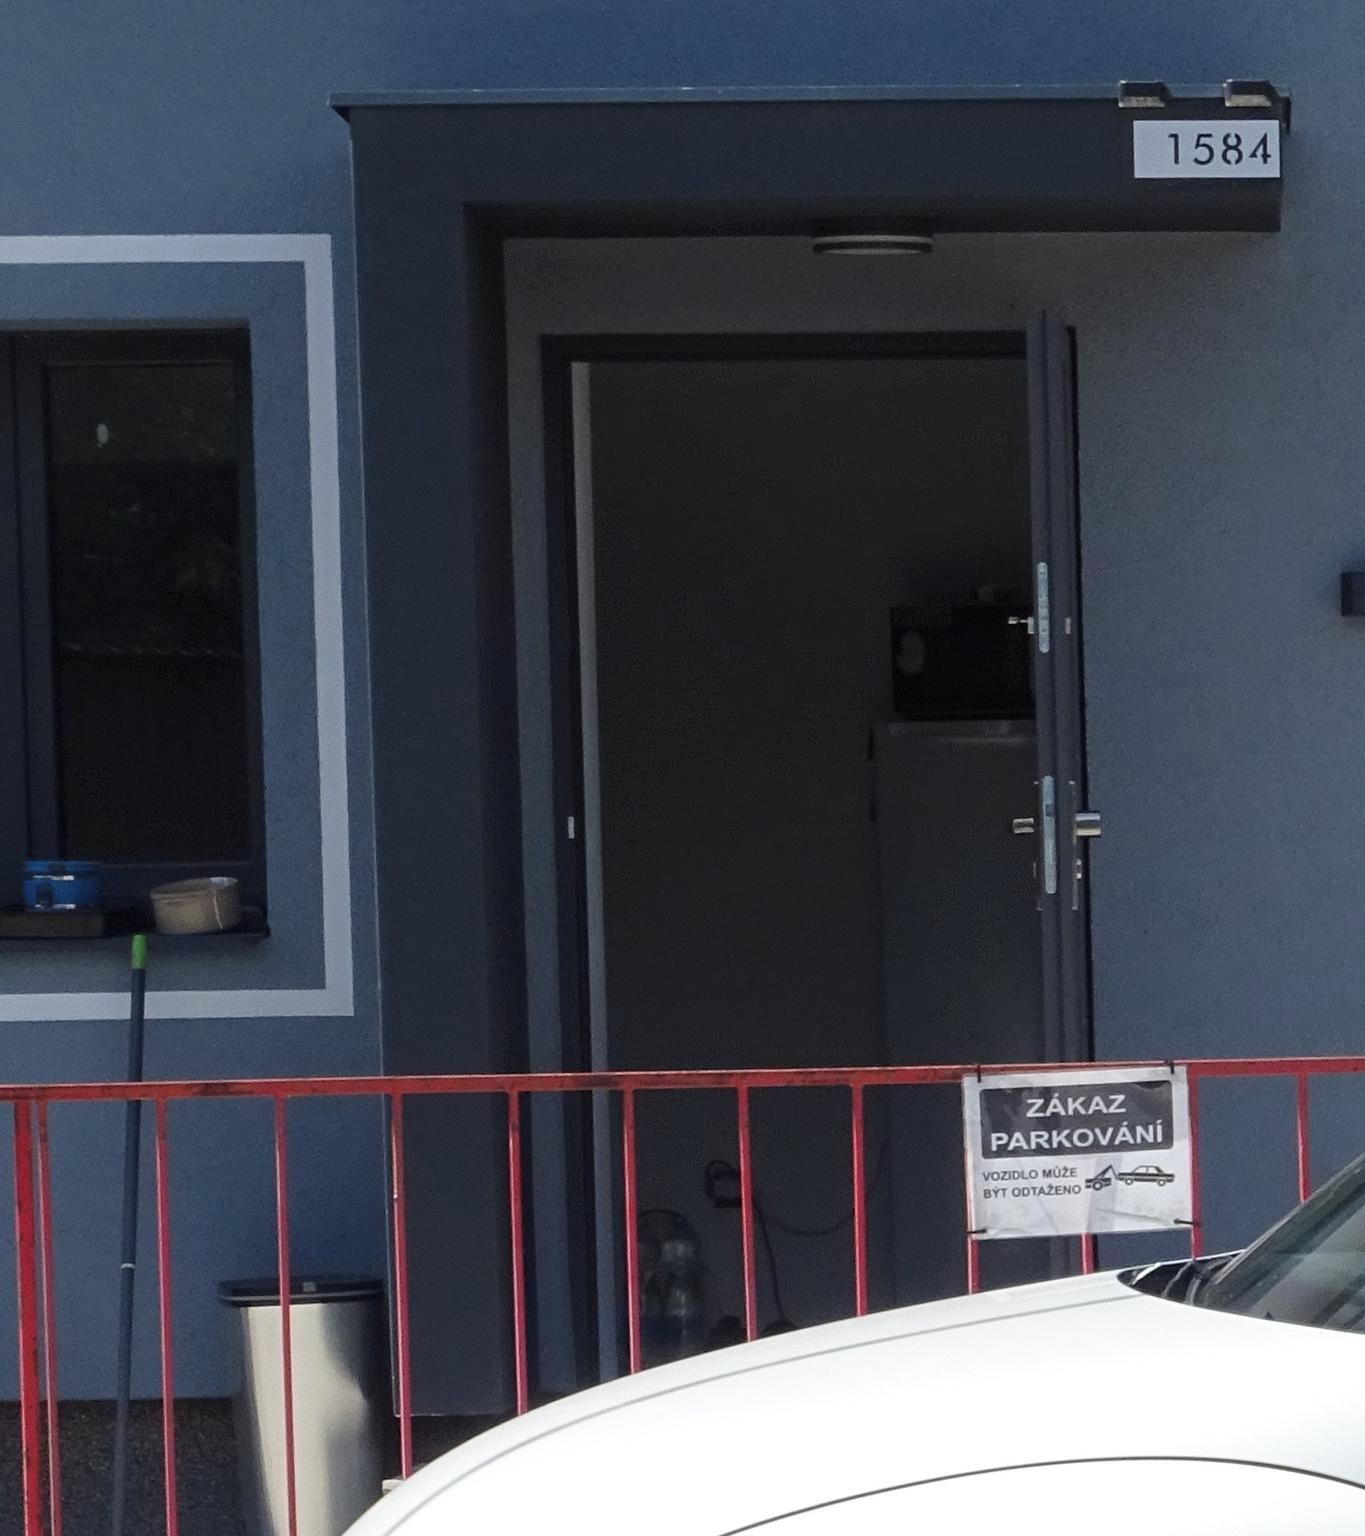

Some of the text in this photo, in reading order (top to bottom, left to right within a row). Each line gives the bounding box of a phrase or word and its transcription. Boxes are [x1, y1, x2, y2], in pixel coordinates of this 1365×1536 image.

[1167, 132, 1271, 166] 1584
[1026, 1093, 1127, 1118] ZÁKAZ
[990, 1119, 1164, 1152] PARKOVÁNÍ
[982, 1165, 1078, 1182] VOZIDLO MŮŽE
[983, 1183, 1082, 1200] BÝT ODTAŽENO
